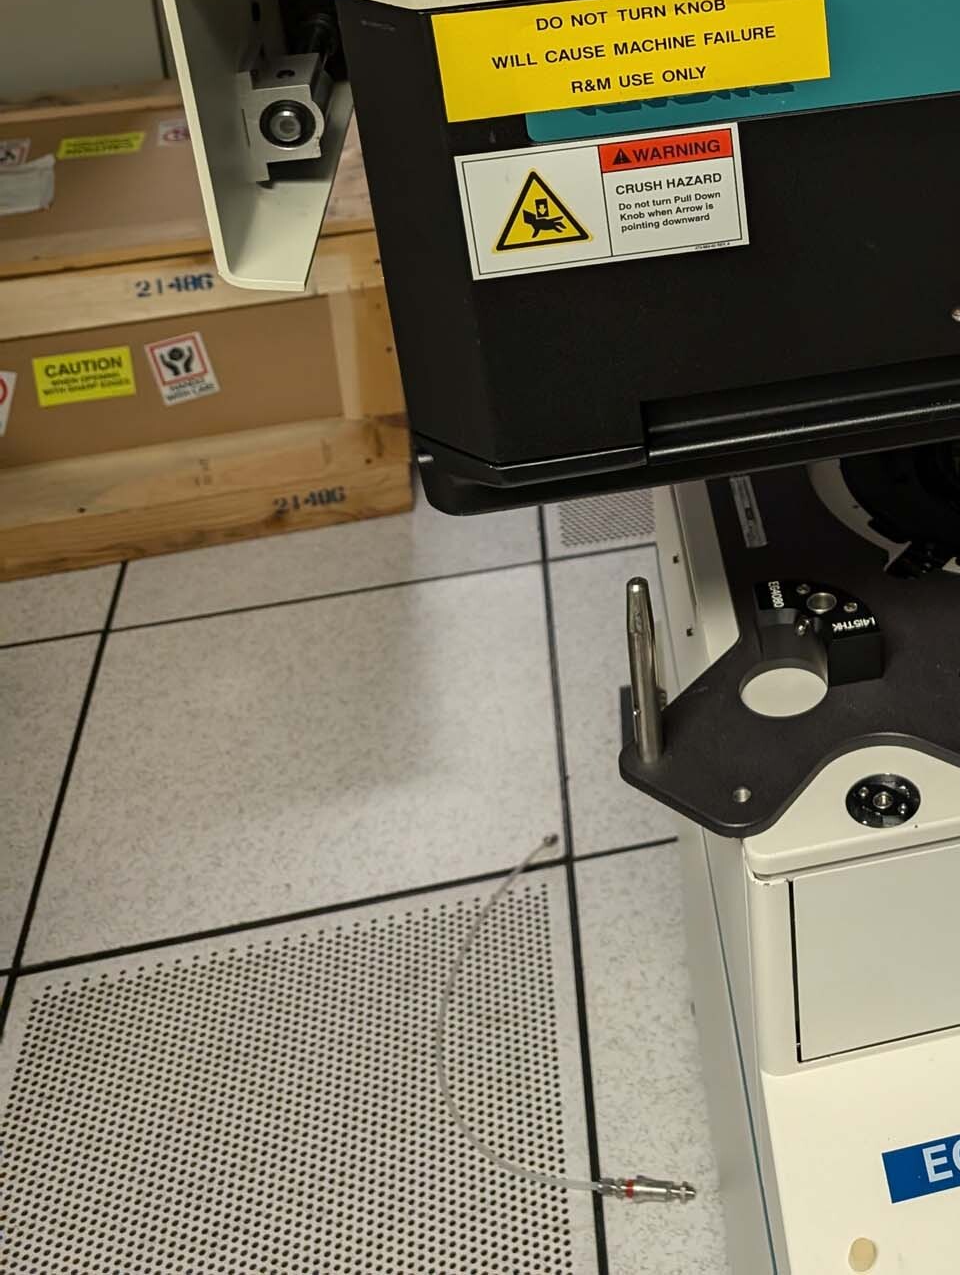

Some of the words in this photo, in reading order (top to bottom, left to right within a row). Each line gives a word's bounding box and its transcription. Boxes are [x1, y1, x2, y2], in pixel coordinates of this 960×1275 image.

[536, 16, 563, 31] DO
[571, 11, 608, 27] NOT
[617, 5, 667, 22] TURN
[491, 55, 538, 70] WILL
[545, 45, 606, 64] CAUSE
[613, 35, 696, 56] MACHINE
[703, 25, 777, 46] FAILURE
[571, 77, 612, 94] R&M
[618, 71, 655, 88] USE
[662, 66, 707, 83] ONLY
[632, 139, 721, 163] WARNING
[615, 180, 663, 195] CRUSH
[666, 172, 722, 189] HAZARD
[618, 203, 632, 211] Do
[634, 200, 650, 209] not
[652, 198, 672, 207] turn
[674, 194, 692, 204] Pull
[694, 191, 721, 201] Down
[620, 212, 645, 222] Knob
[648, 209, 673, 218] when
[675, 205, 703, 214] Arrow
[705, 202, 714, 210] is
[620, 220, 660, 233] pointing
[662, 213, 711, 226] downward
[44, 356, 123, 378] CAUTION
